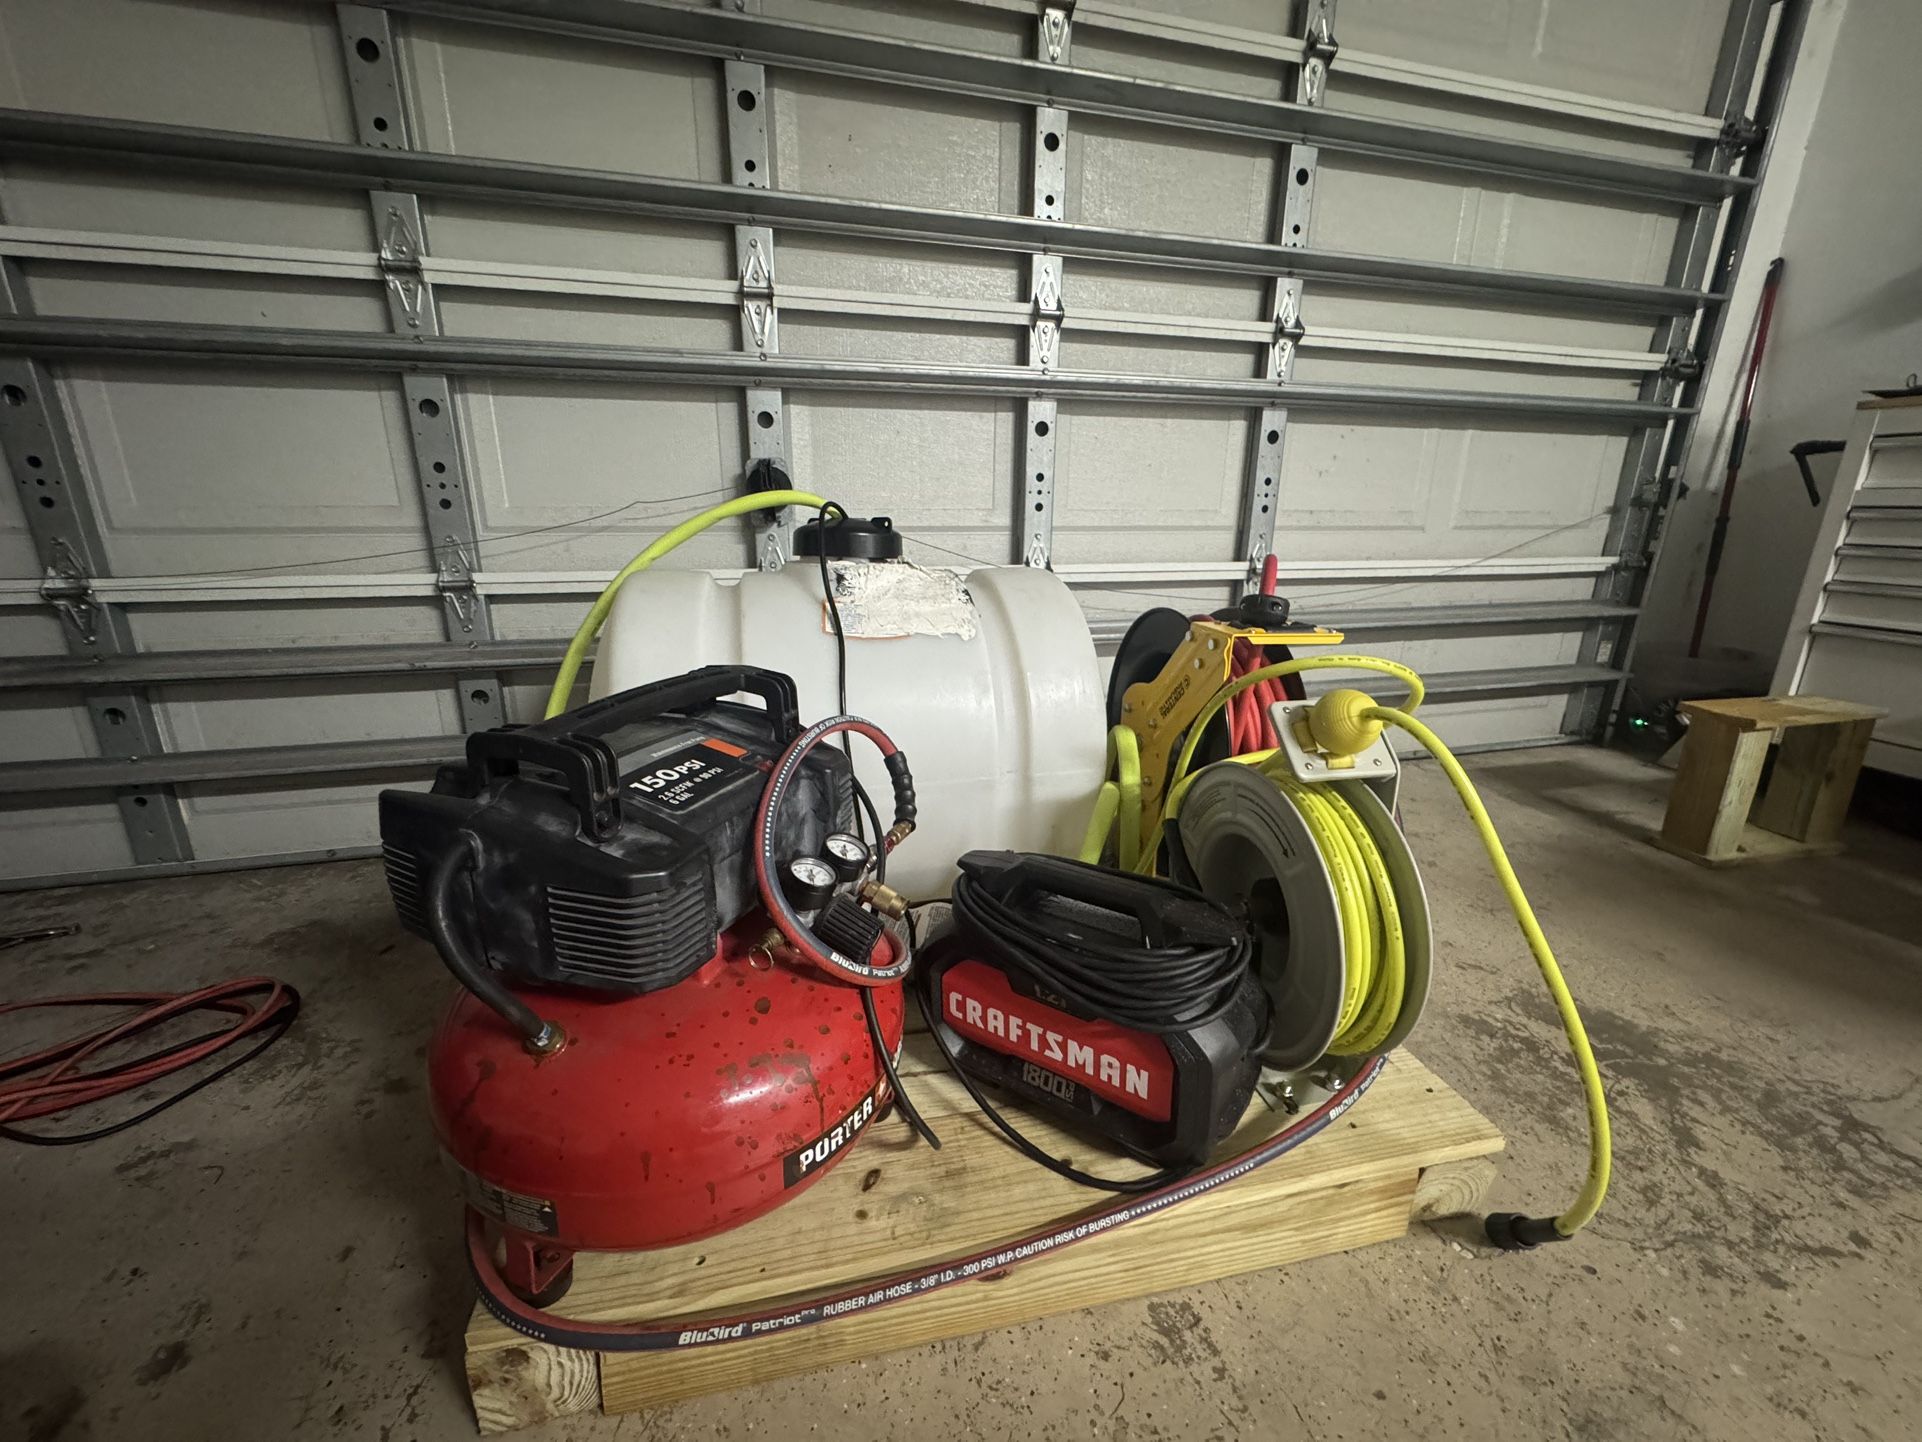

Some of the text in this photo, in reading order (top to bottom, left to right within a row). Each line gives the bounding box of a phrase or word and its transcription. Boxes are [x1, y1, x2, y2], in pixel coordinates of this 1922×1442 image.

[629, 759, 706, 793] 150 PSI
[658, 789, 675, 801] 2.6
[675, 791, 695, 802] GAL
[948, 990, 1150, 1100] CRAFTSMAN
[1022, 1062, 1067, 1100] 1800
[799, 1095, 874, 1174] PORTER
[678, 1323, 743, 1345] BluBird
[823, 1295, 866, 1317] RUBBER
[866, 1289, 885, 1305] AIR
[885, 1281, 913, 1299] HOSE
[940, 1269, 955, 1283] I.D.
[962, 1261, 981, 1277] 300
[980, 1257, 997, 1271] PSI
[1015, 1238, 1055, 1259] CAUTION
[1055, 1228, 1076, 1246] RISK
[1075, 1224, 1090, 1238] OF
[1088, 1210, 1130, 1233] BURSTING
